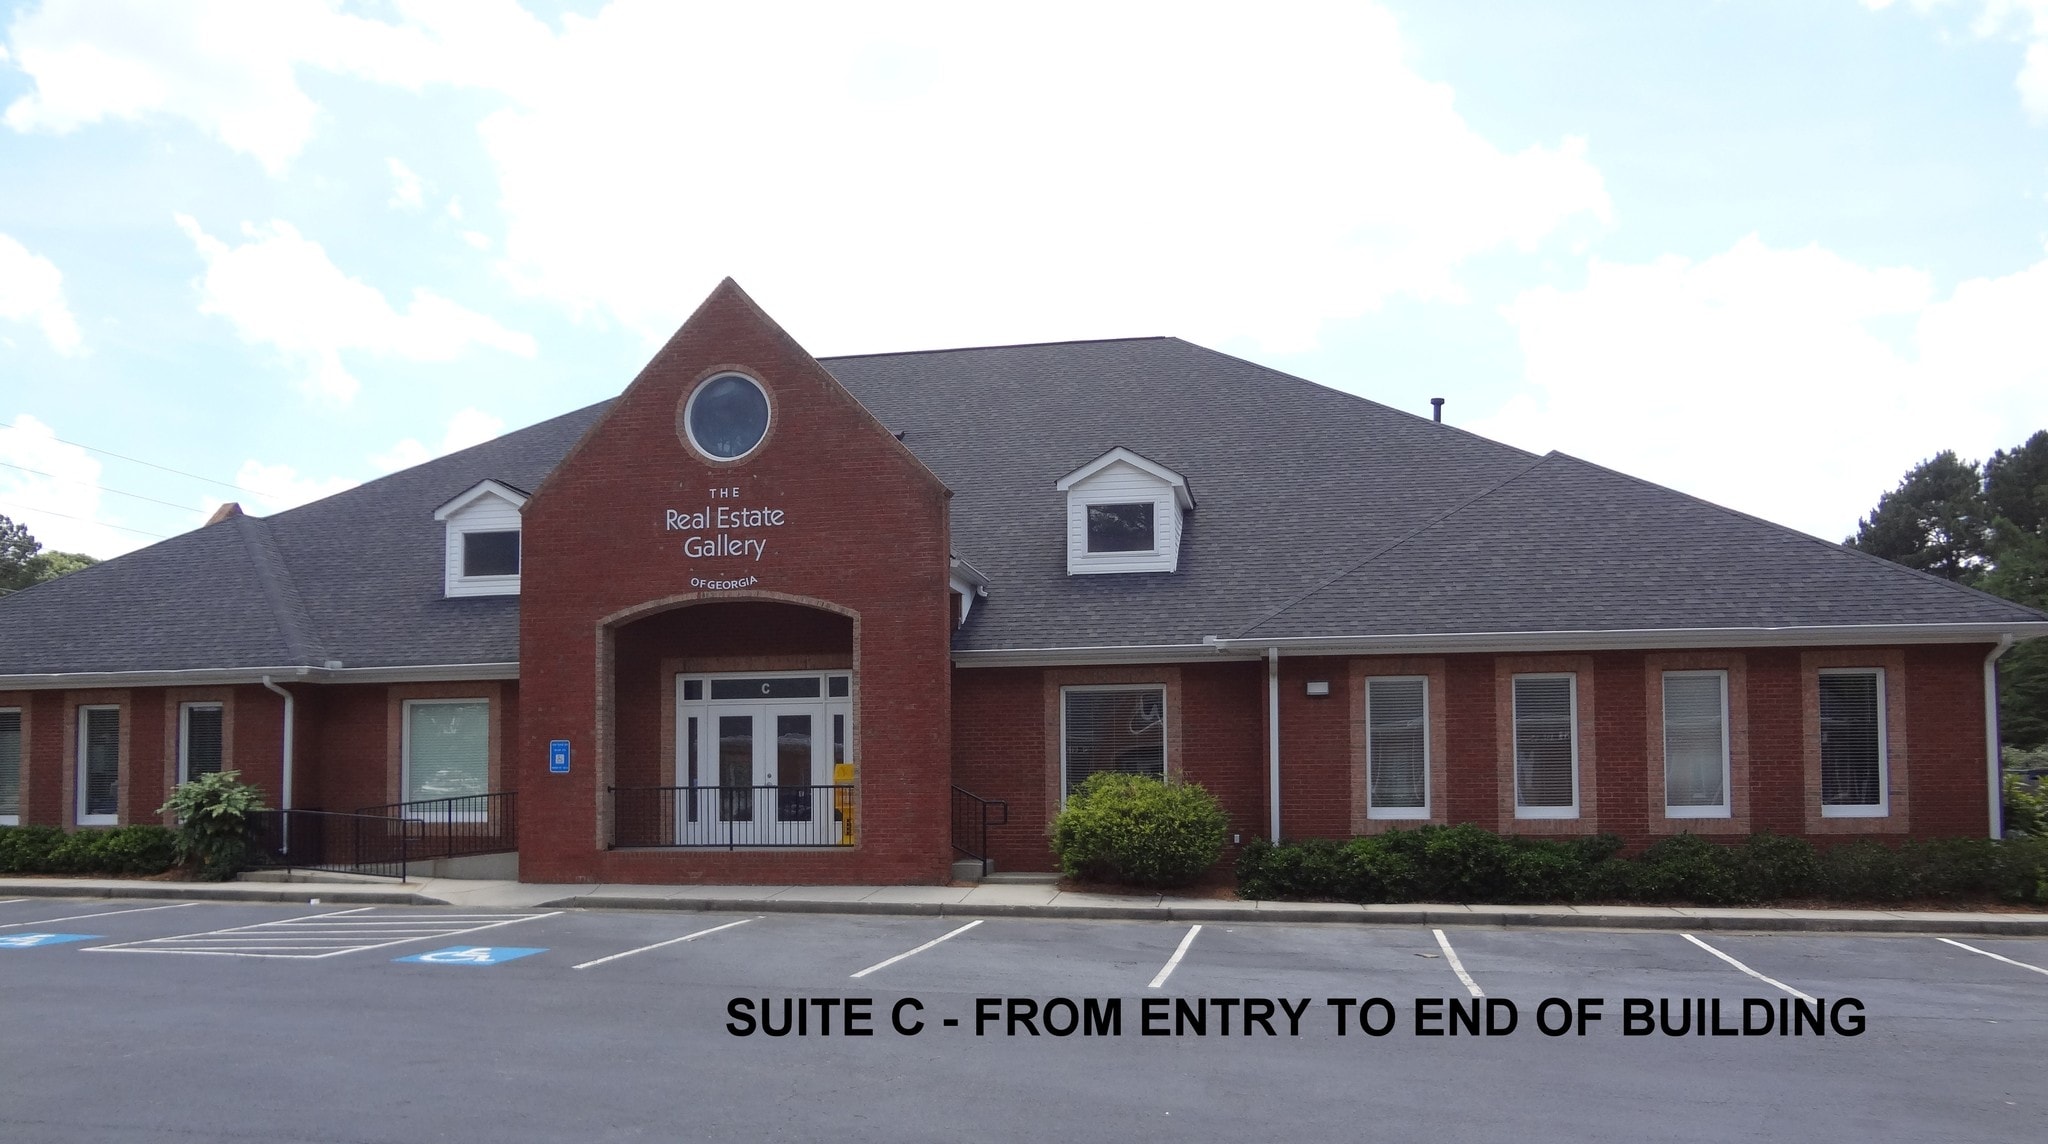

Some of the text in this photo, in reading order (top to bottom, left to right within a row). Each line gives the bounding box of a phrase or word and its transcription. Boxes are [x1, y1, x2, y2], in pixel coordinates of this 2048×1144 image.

[709, 487, 740, 499] THE
[666, 505, 785, 531] Real Estate
[684, 533, 767, 562] Gallery
[690, 575, 758, 590] OF GEORGIA
[761, 682, 770, 694] C
